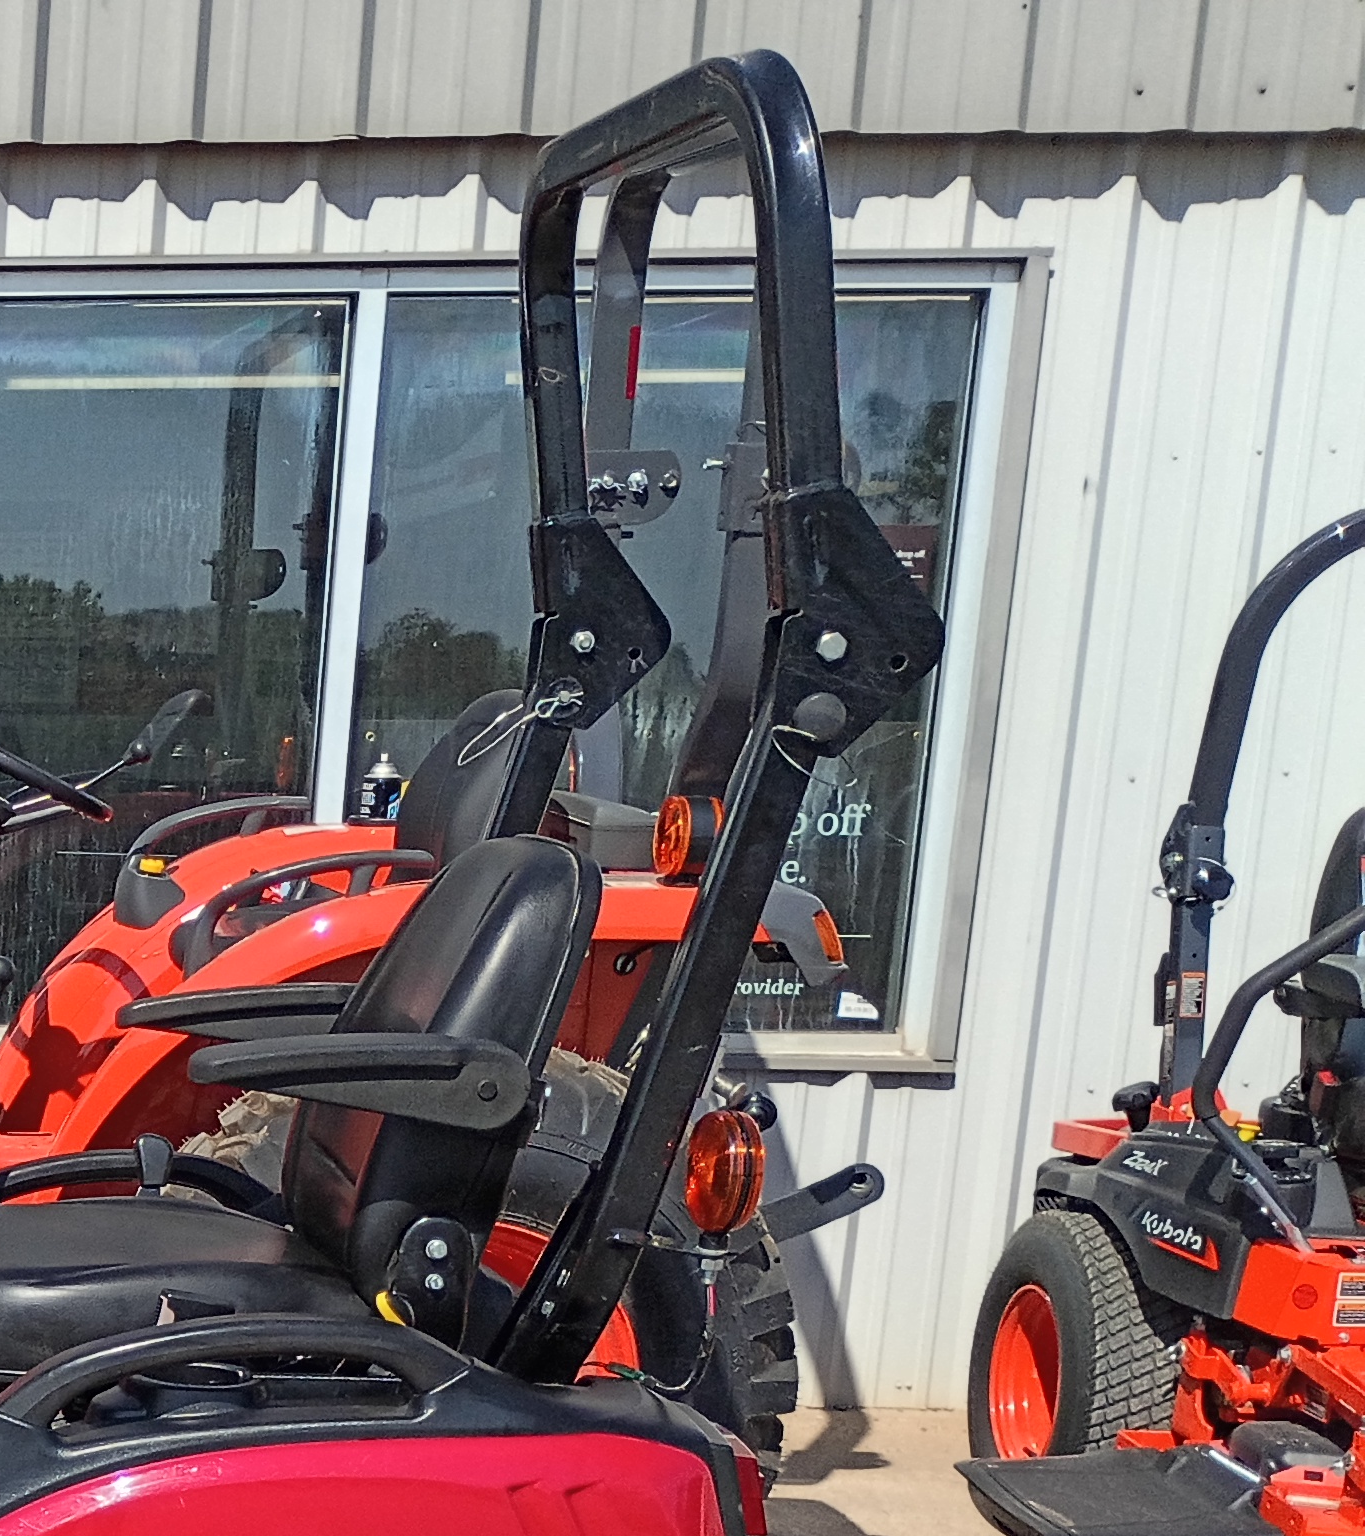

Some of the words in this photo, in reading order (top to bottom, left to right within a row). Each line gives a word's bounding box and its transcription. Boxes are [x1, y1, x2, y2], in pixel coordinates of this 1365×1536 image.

[816, 803, 872, 837] off
[733, 978, 805, 996] rovider
[1141, 1210, 1203, 1250] Kubota
